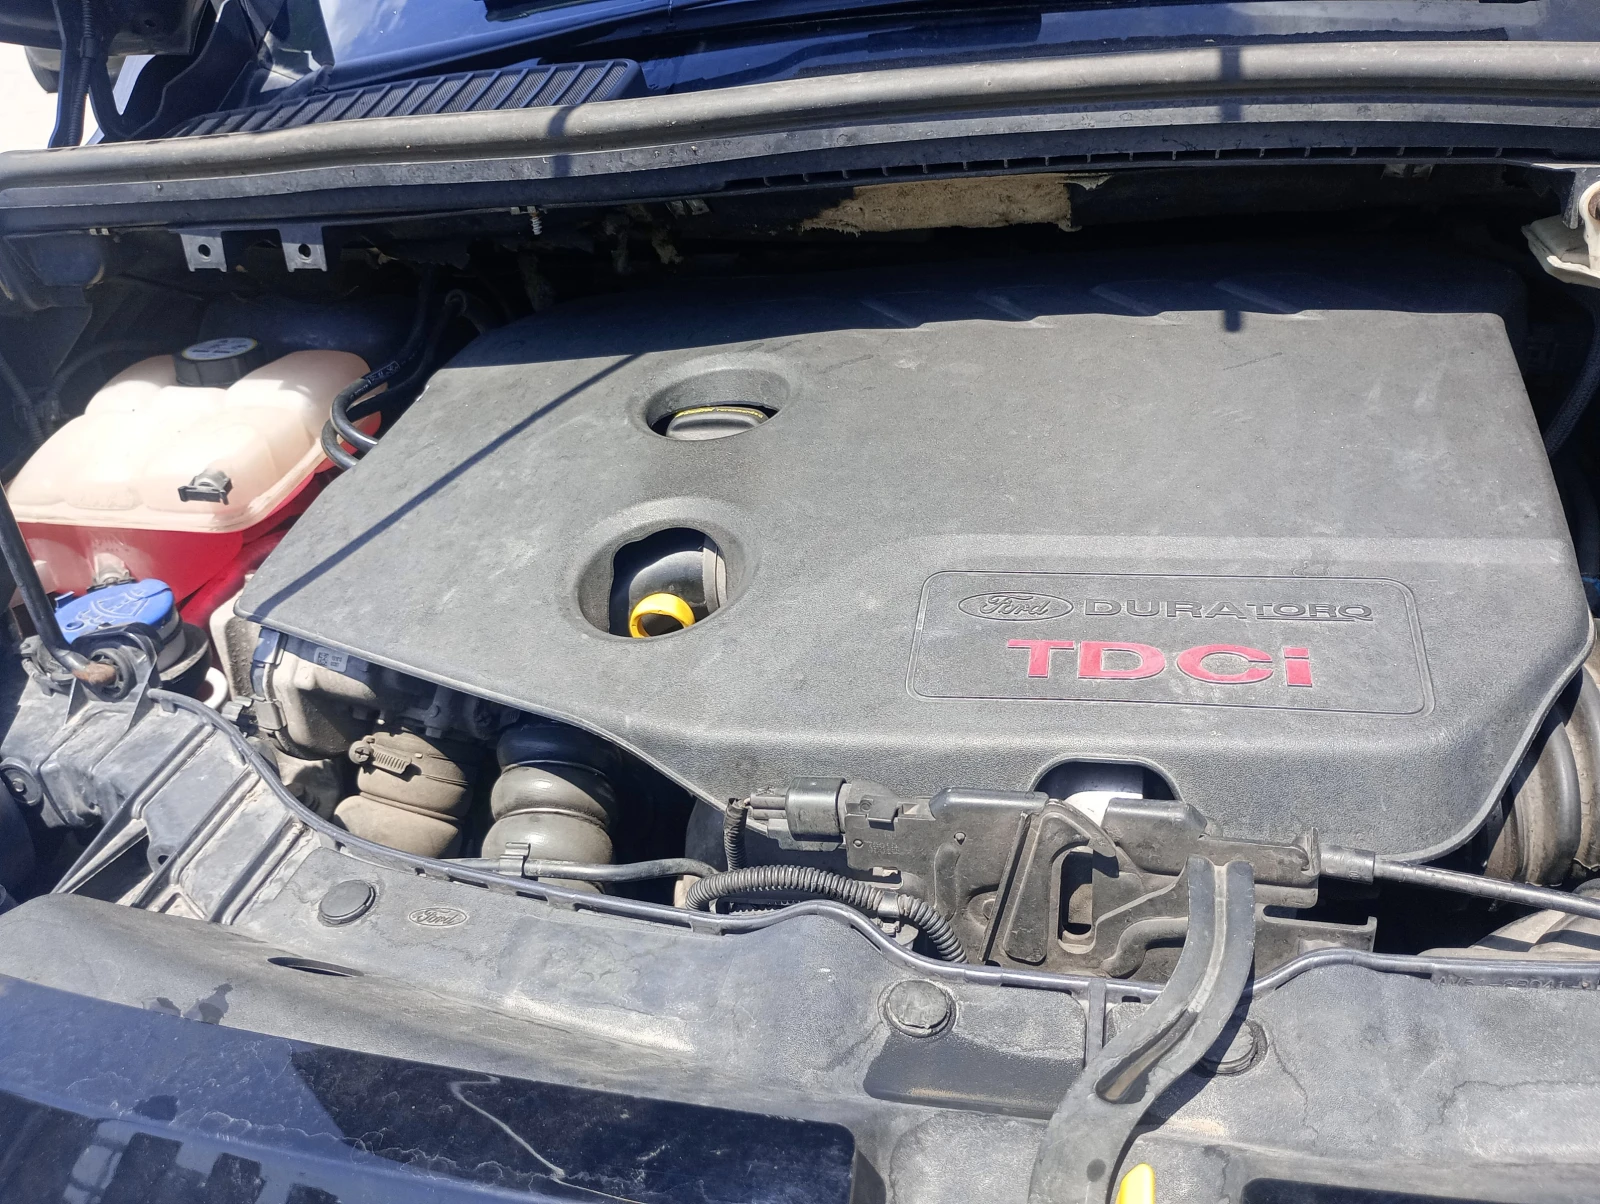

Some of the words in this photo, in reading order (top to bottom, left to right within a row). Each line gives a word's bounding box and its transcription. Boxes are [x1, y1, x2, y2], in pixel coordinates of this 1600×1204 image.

[976, 592, 1053, 617] Ford
[1084, 599, 1374, 621] DURATORQ
[1007, 638, 1313, 688] TDCi
[415, 907, 460, 925] Ford
